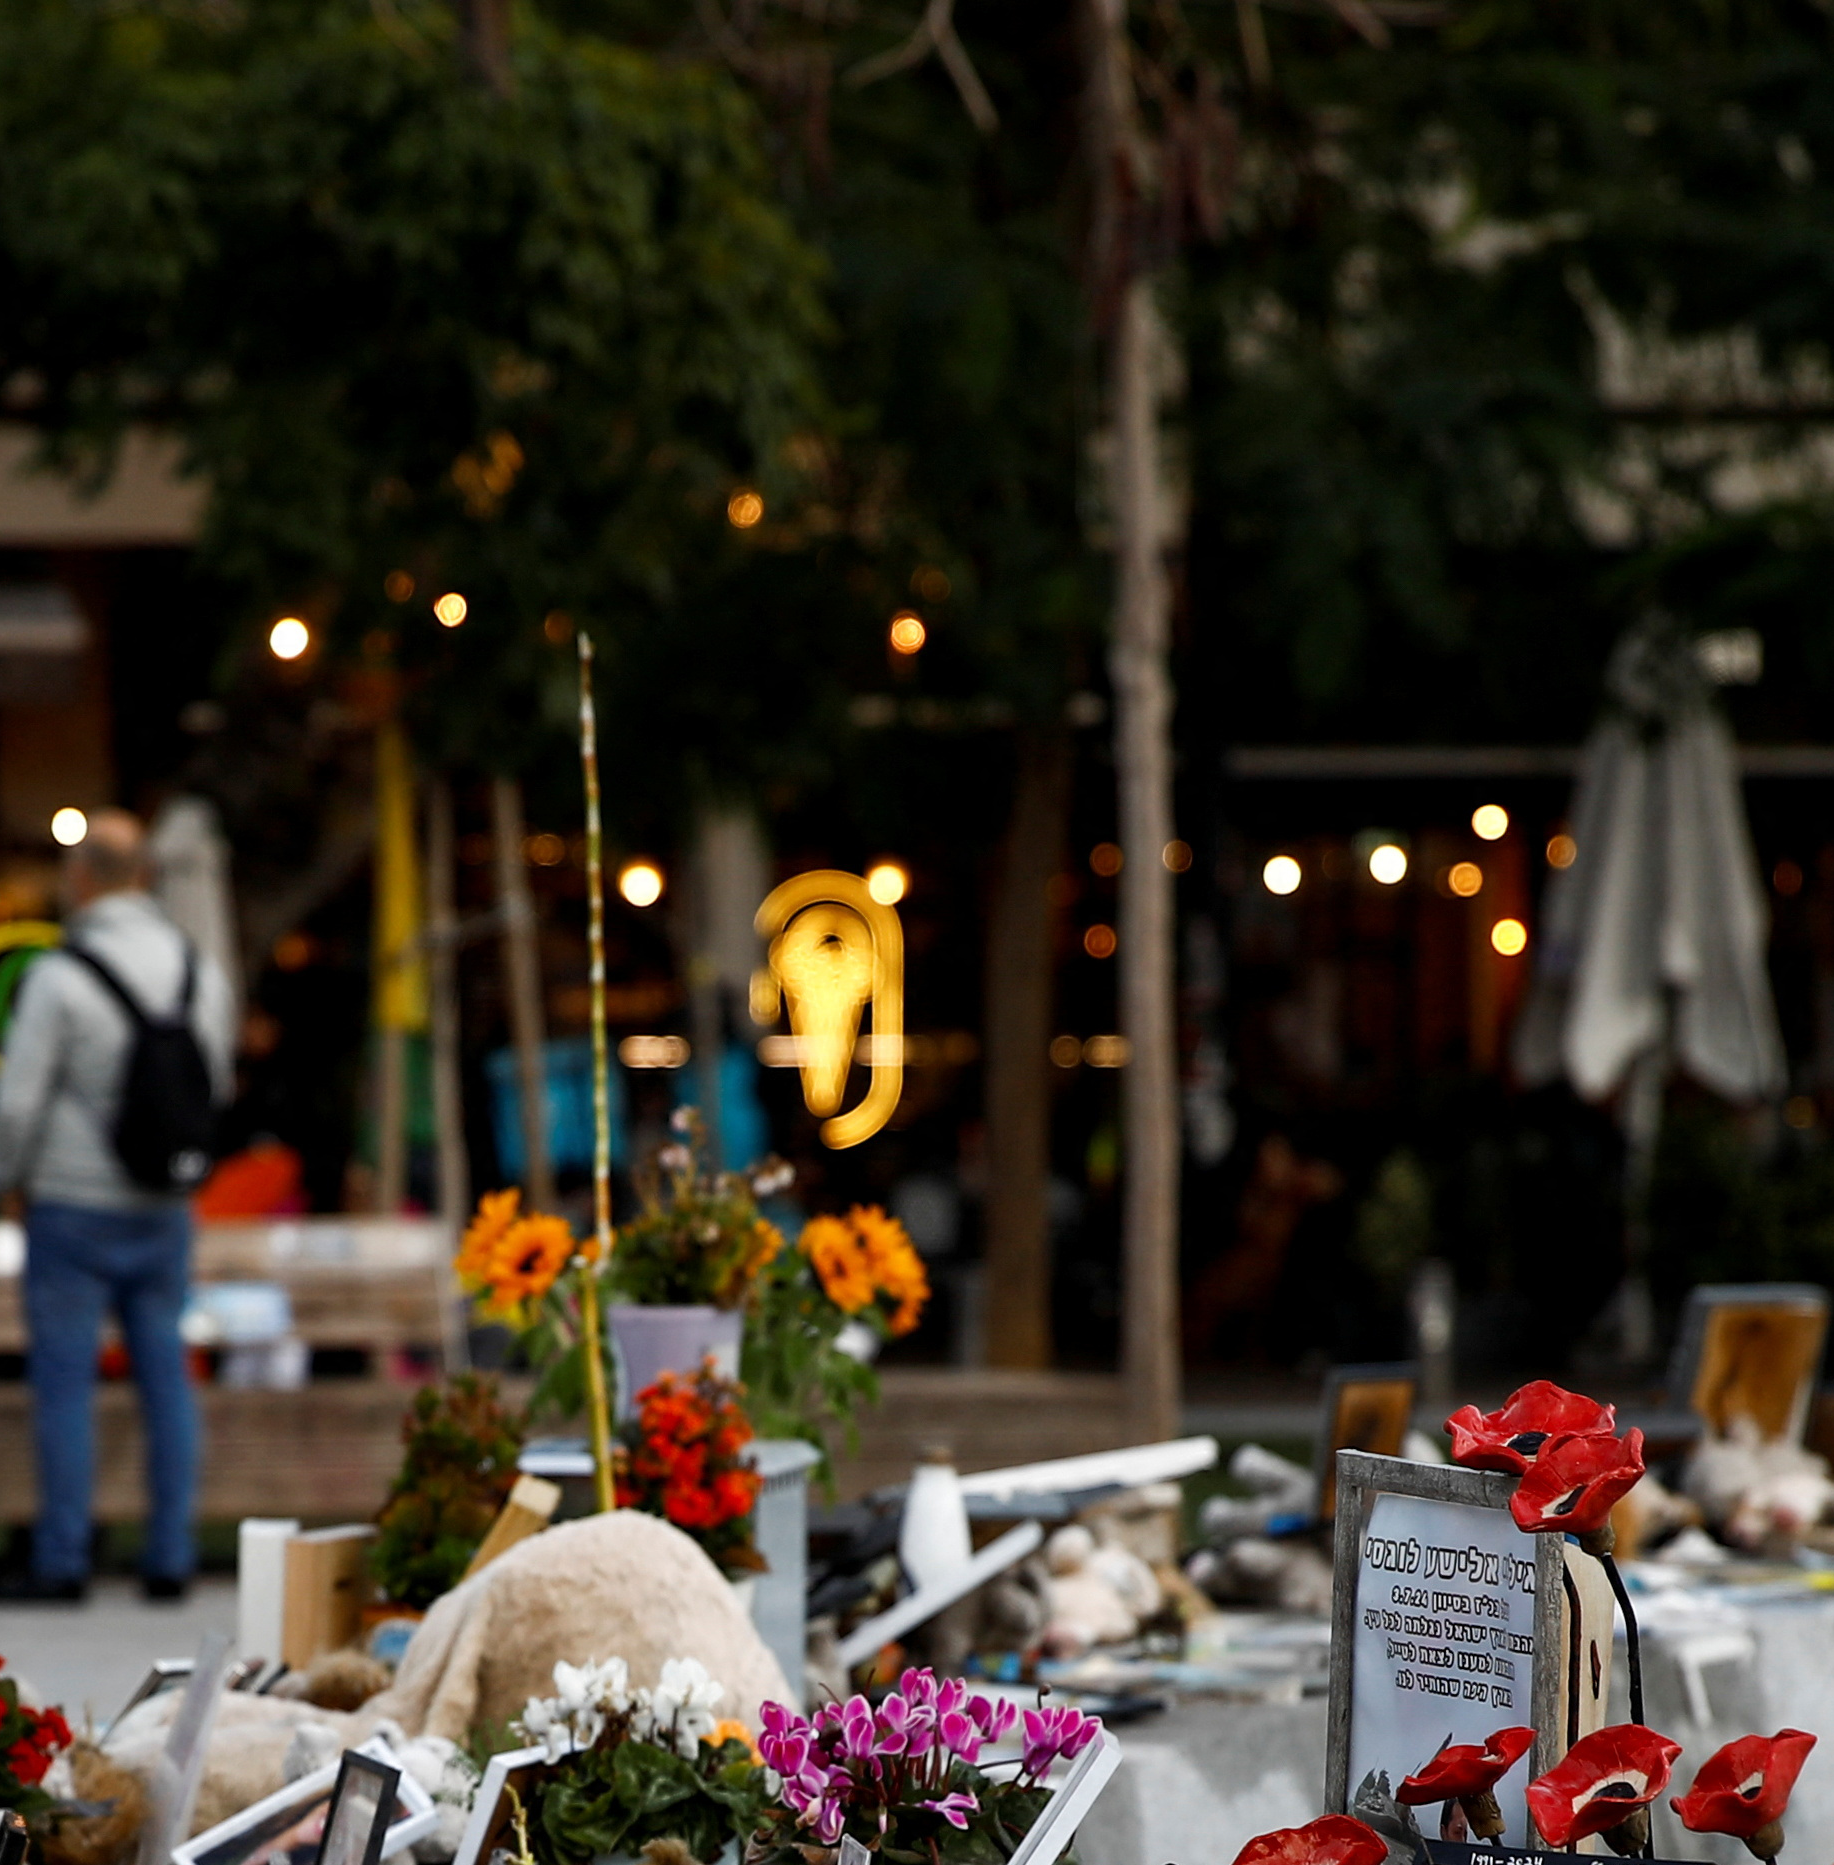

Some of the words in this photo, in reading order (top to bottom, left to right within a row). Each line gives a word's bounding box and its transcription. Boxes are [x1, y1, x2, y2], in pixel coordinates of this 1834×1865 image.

[1365, 1536, 1420, 1574] לוגסי
[1424, 1545, 1498, 1585] אלישע
[1391, 1585, 1429, 1608] 3.7.24
[1432, 1591, 1471, 1614] בסיוון
[1382, 1609, 1402, 1631] לכל
[1404, 1614, 1442, 1639] נגלתה
[1444, 1619, 1487, 1644] ישראל
[1419, 1646, 1455, 1668] לצאת
[1416, 1673, 1461, 1697] שהותיר
[1462, 1680, 1489, 1702] היפה
